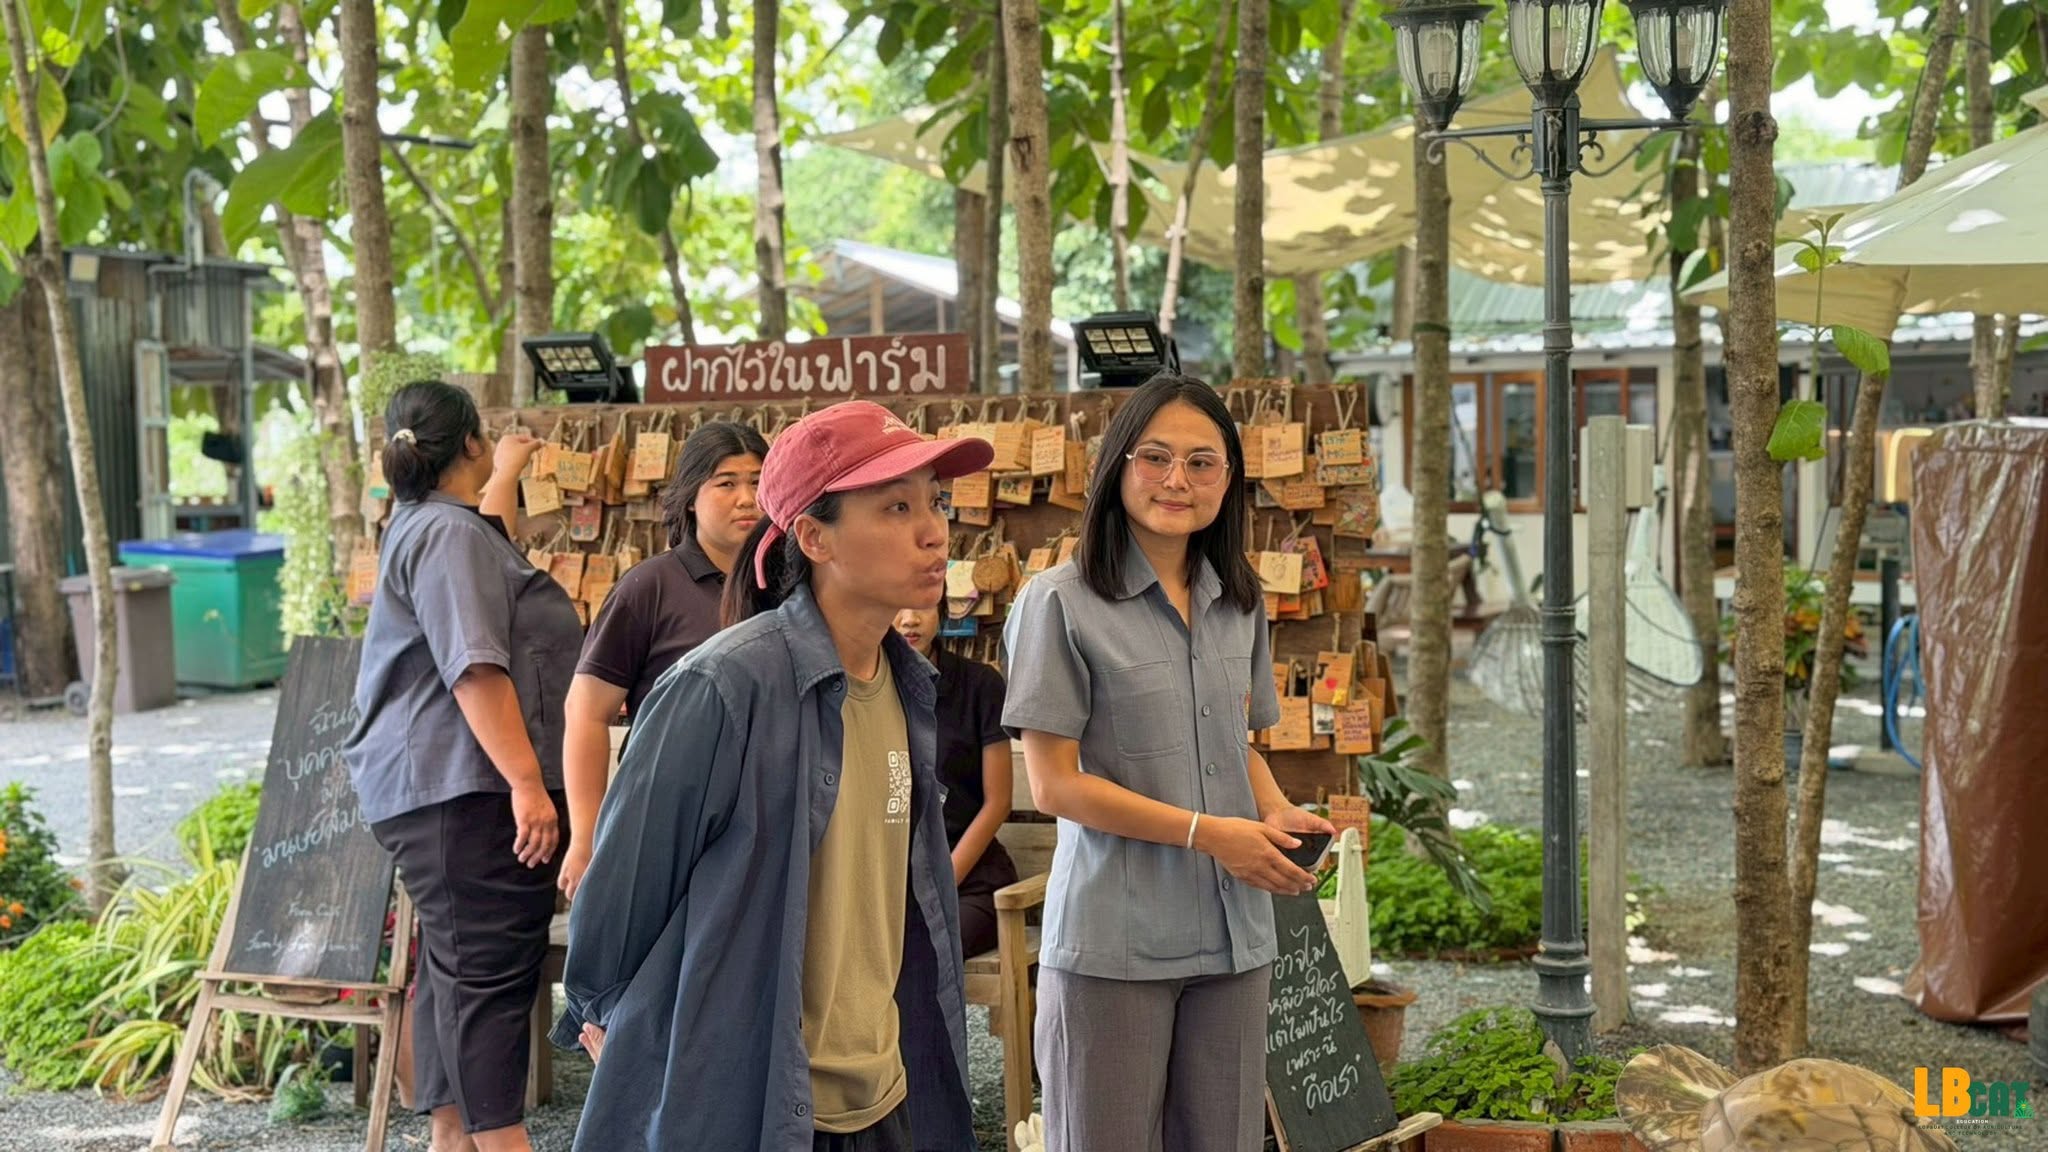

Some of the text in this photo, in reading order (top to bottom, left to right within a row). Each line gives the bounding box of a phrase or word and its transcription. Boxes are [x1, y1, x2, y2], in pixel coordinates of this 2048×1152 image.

[662, 337, 946, 393] ฝากไว้ในฟาร์ม
[1274, 925, 1328, 980] อาจไม่
